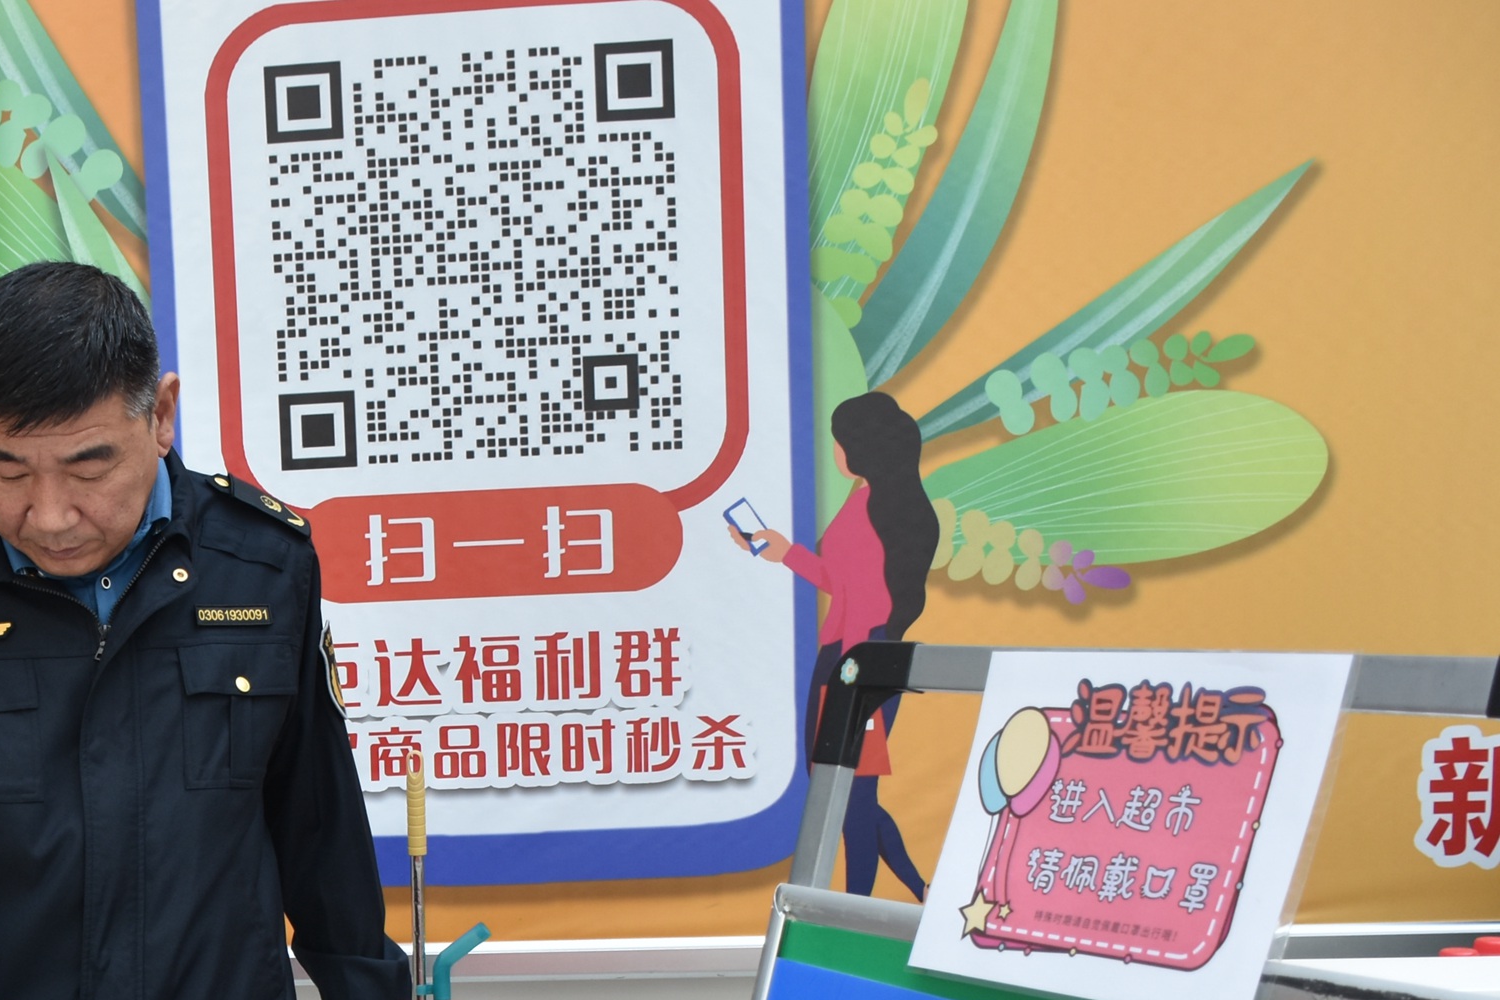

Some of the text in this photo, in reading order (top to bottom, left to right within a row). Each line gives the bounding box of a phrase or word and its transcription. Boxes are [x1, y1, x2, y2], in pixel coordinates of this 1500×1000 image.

[364, 505, 614, 586] 扫一扫
[198, 608, 268, 621] 03061930091
[349, 714, 747, 783] 商品限时秒杀
[1062, 679, 1270, 766] 温馨提示
[1048, 779, 1202, 836] 进入超市
[1027, 848, 1219, 914] 请佩戴口罩
